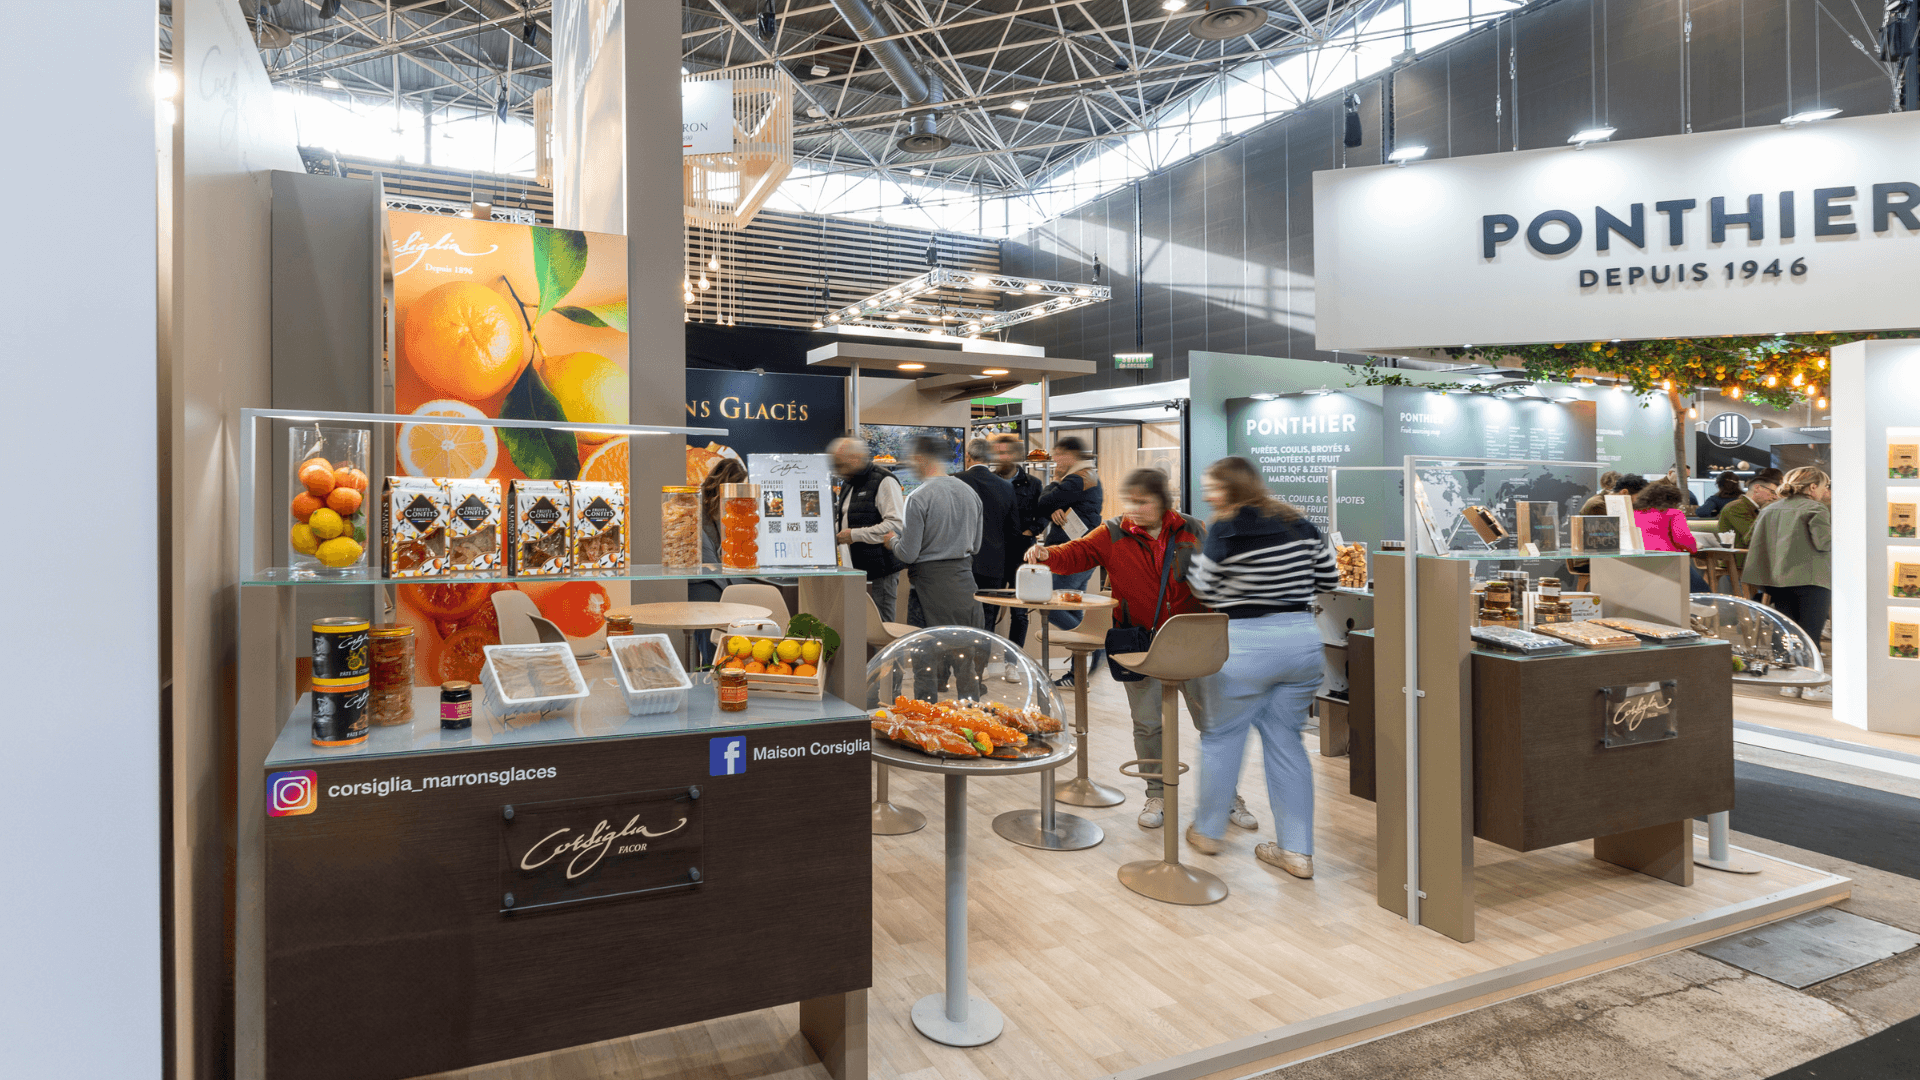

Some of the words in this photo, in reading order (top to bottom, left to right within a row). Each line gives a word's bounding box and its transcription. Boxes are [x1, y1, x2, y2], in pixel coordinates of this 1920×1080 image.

[1481, 181, 1920, 260] PONTHIER
[425, 263, 452, 273] Depuis
[454, 266, 474, 275] 1896
[1579, 262, 1709, 289] DEPUIS
[1724, 256, 1808, 281] 1946
[1246, 414, 1356, 436] PONTHIER
[1251, 446, 1279, 455] PURÉES,
[1280, 445, 1310, 454] COULIS,
[1311, 443, 1342, 453] BROYÉS
[1259, 455, 1303, 463] COMPOTÉES
[1305, 455, 1315, 463] DE
[1317, 455, 1340, 463] FRUIT
[1288, 466, 1301, 474] IQF
[1268, 475, 1306, 483] MARRONS
[1288, 495, 1314, 503] COULIS
[1316, 495, 1321, 503] &
[1323, 496, 1365, 504] CMPOTES
[404, 509, 440, 518] CONFITS
[456, 508, 490, 516] CONFITS
[584, 509, 615, 517] CONFITS
[1306, 505, 1328, 513] FRUIT
[529, 510, 560, 519] CONFITS
[753, 743, 806, 761] Maison
[809, 738, 871, 760] Corsiglia
[327, 764, 557, 799] corsiglia_marronsglaces
[520, 814, 687, 880] Corsiglia
[618, 843, 648, 854] FACOR
